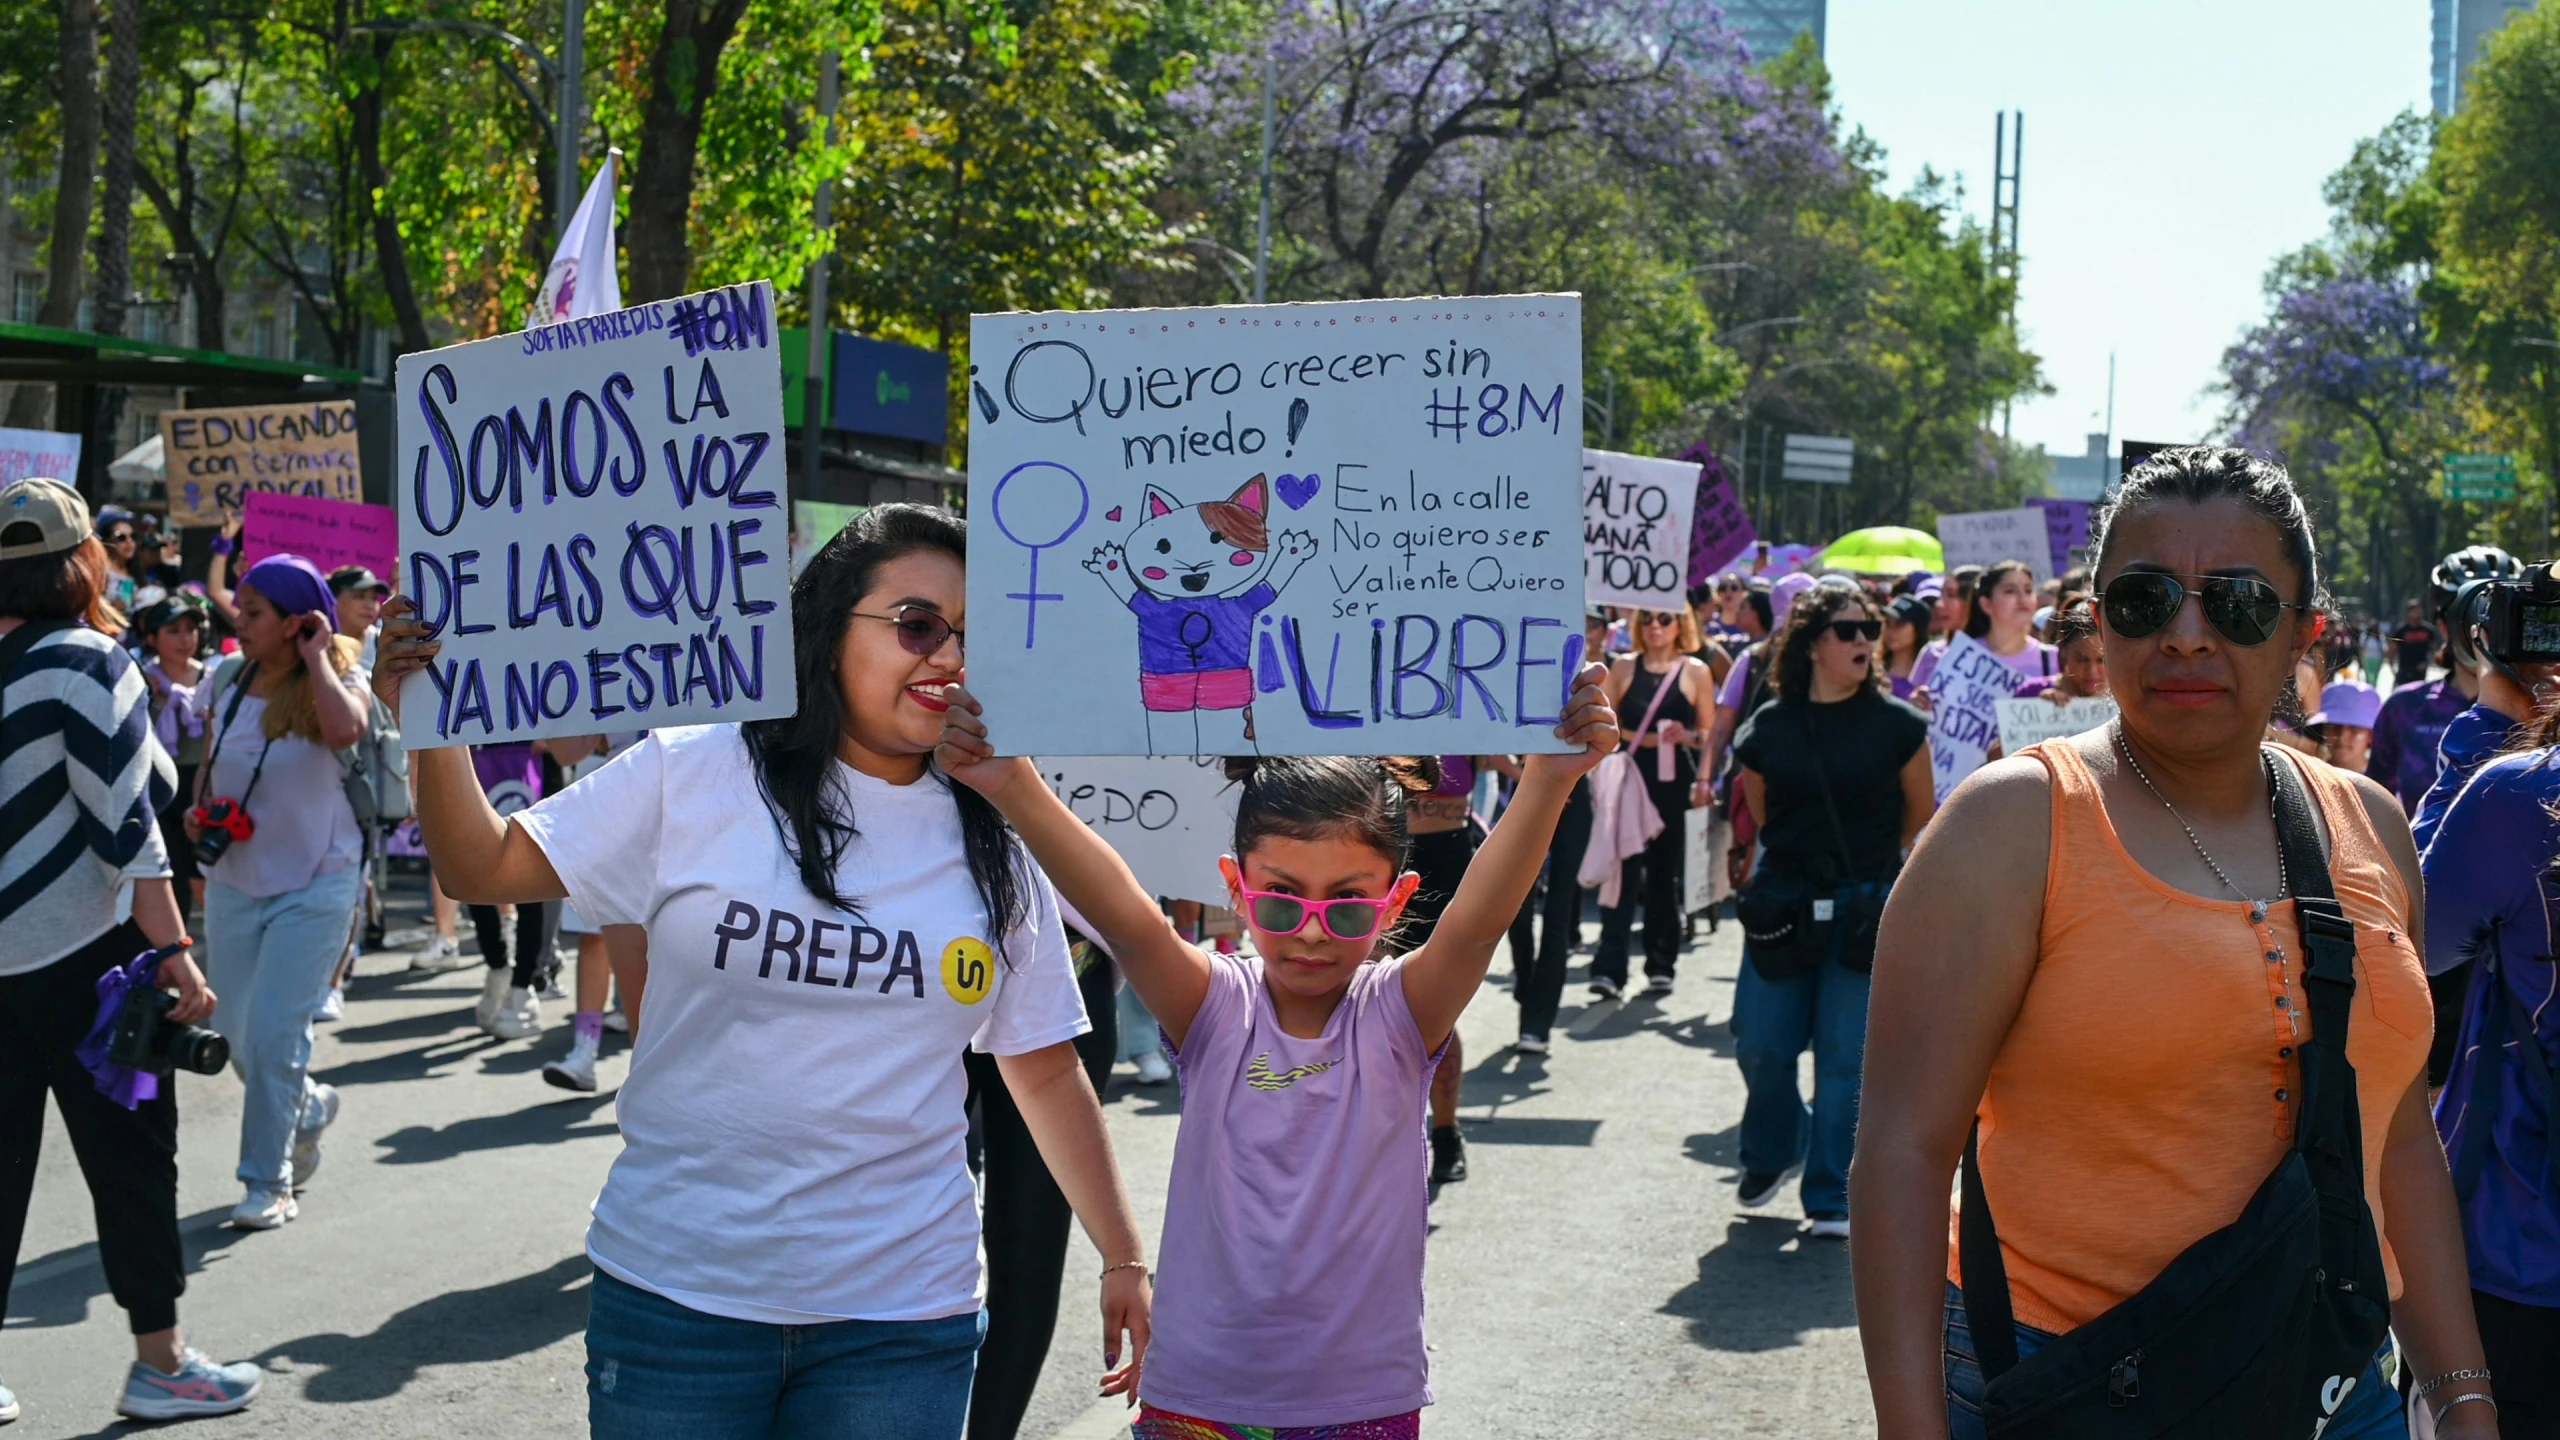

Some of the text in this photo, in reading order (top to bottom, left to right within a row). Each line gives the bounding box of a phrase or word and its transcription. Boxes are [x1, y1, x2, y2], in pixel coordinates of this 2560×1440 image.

[576, 304, 664, 347] PRAXEDIS
[666, 283, 769, 358] #8M
[1260, 352, 1405, 389] crecer
[1423, 339, 1491, 379] sin
[172, 406, 356, 450] EDUCANDO
[414, 357, 730, 537] SOMOS LA
[188, 455, 239, 476] con
[664, 431, 781, 510] VOZ
[1335, 463, 1531, 513] En la calle
[1333, 517, 1381, 553] No
[1393, 525, 1489, 572] quiero
[410, 517, 779, 641] DE LAS QUE
[1329, 556, 1460, 594] Valiente
[1467, 556, 1566, 592] Quiero
[1593, 550, 1679, 593] TODO
[1332, 597, 1379, 619] ser
[425, 615, 765, 741] YA NO ESTÁN
[1952, 645, 2026, 694] ESTAR
[714, 899, 925, 999] PREPA
